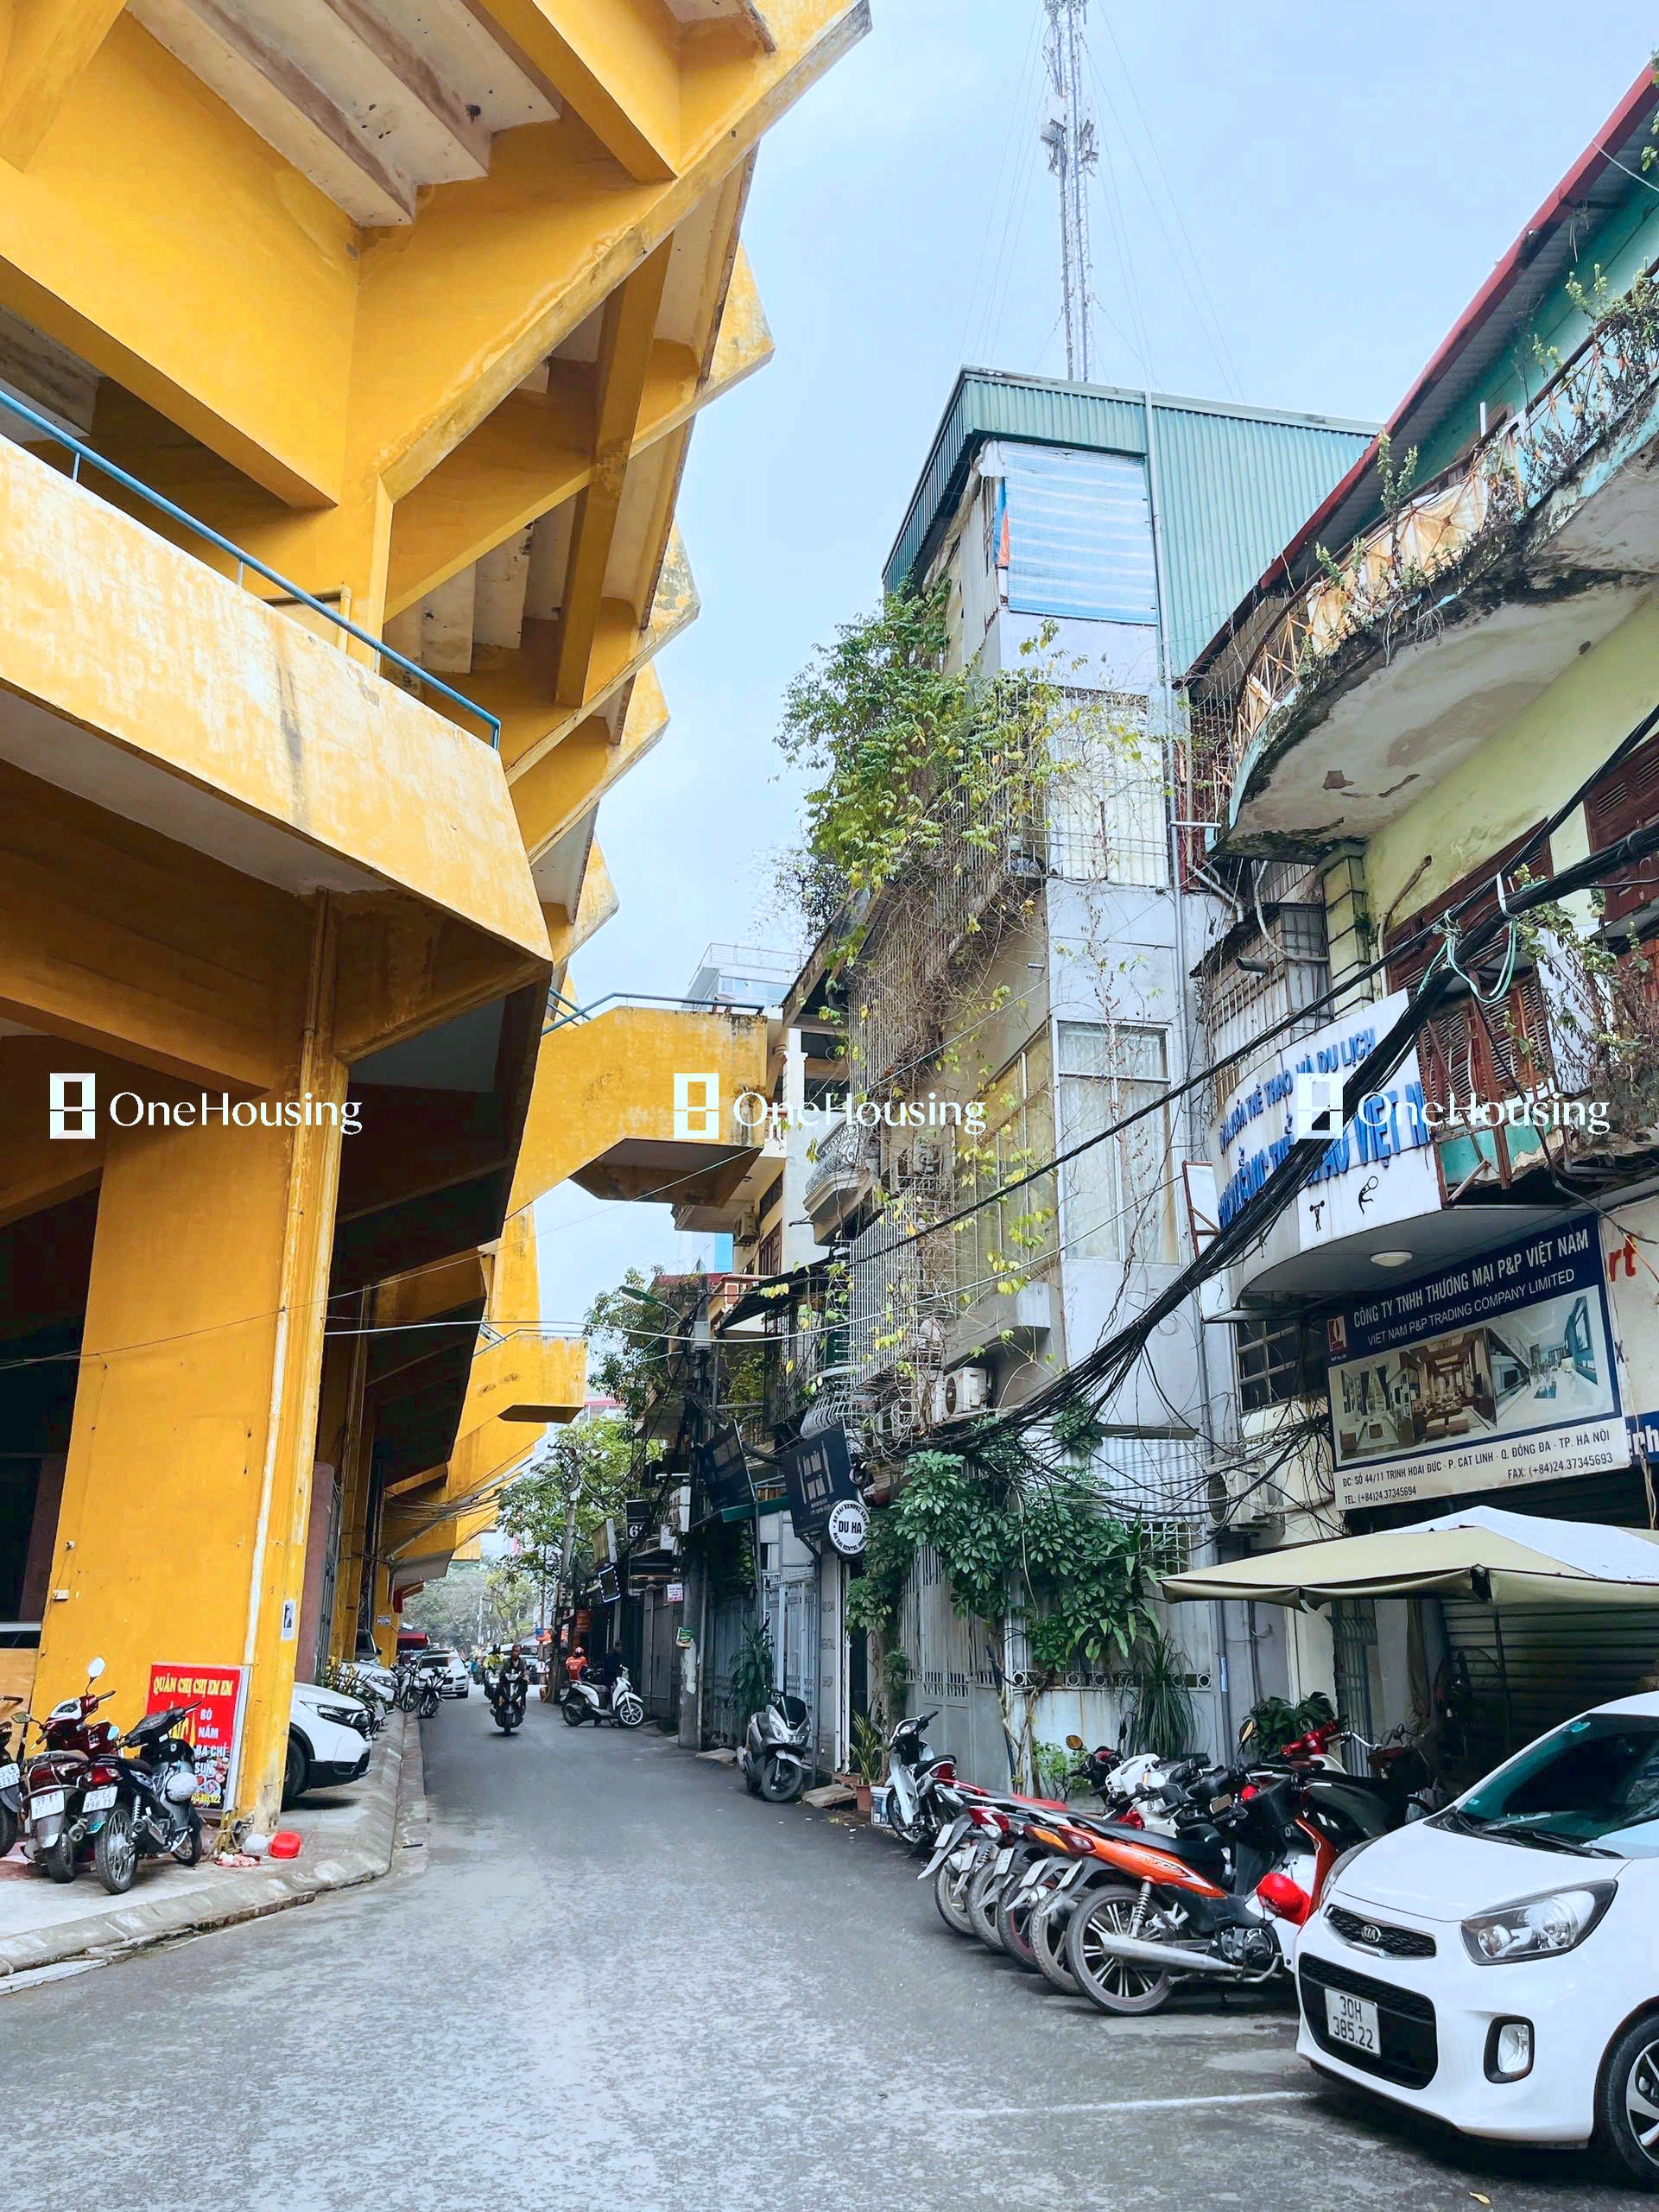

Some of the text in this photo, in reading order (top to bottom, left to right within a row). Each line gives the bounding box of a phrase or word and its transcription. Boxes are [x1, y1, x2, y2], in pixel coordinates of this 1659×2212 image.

[1263, 1068, 1293, 1107] THAO
[1316, 1044, 1339, 1073] DU
[1353, 1228, 1589, 1328] CÔNG TY TNHH THƯƠNG MẠI P&P VIỆT NAM
[1367, 1268, 1575, 1347] VIET NAM P&P TRADING COMPANY LIMITED
[1365, 1472, 1384, 1484] 44/11
[1475, 1452, 1493, 1464] LINH
[1538, 1441, 1551, 1453] ĐA
[1559, 1436, 1574, 1448] TP.
[1508, 1467, 1526, 1480] FAX:
[1345, 1495, 1357, 1505] TEL:
[839, 1520, 862, 1534] DU HA
[1364, 1926, 1378, 1940] KIA
[1339, 1995, 1363, 2023] 30H
[1333, 2016, 1374, 2050] 385.22
